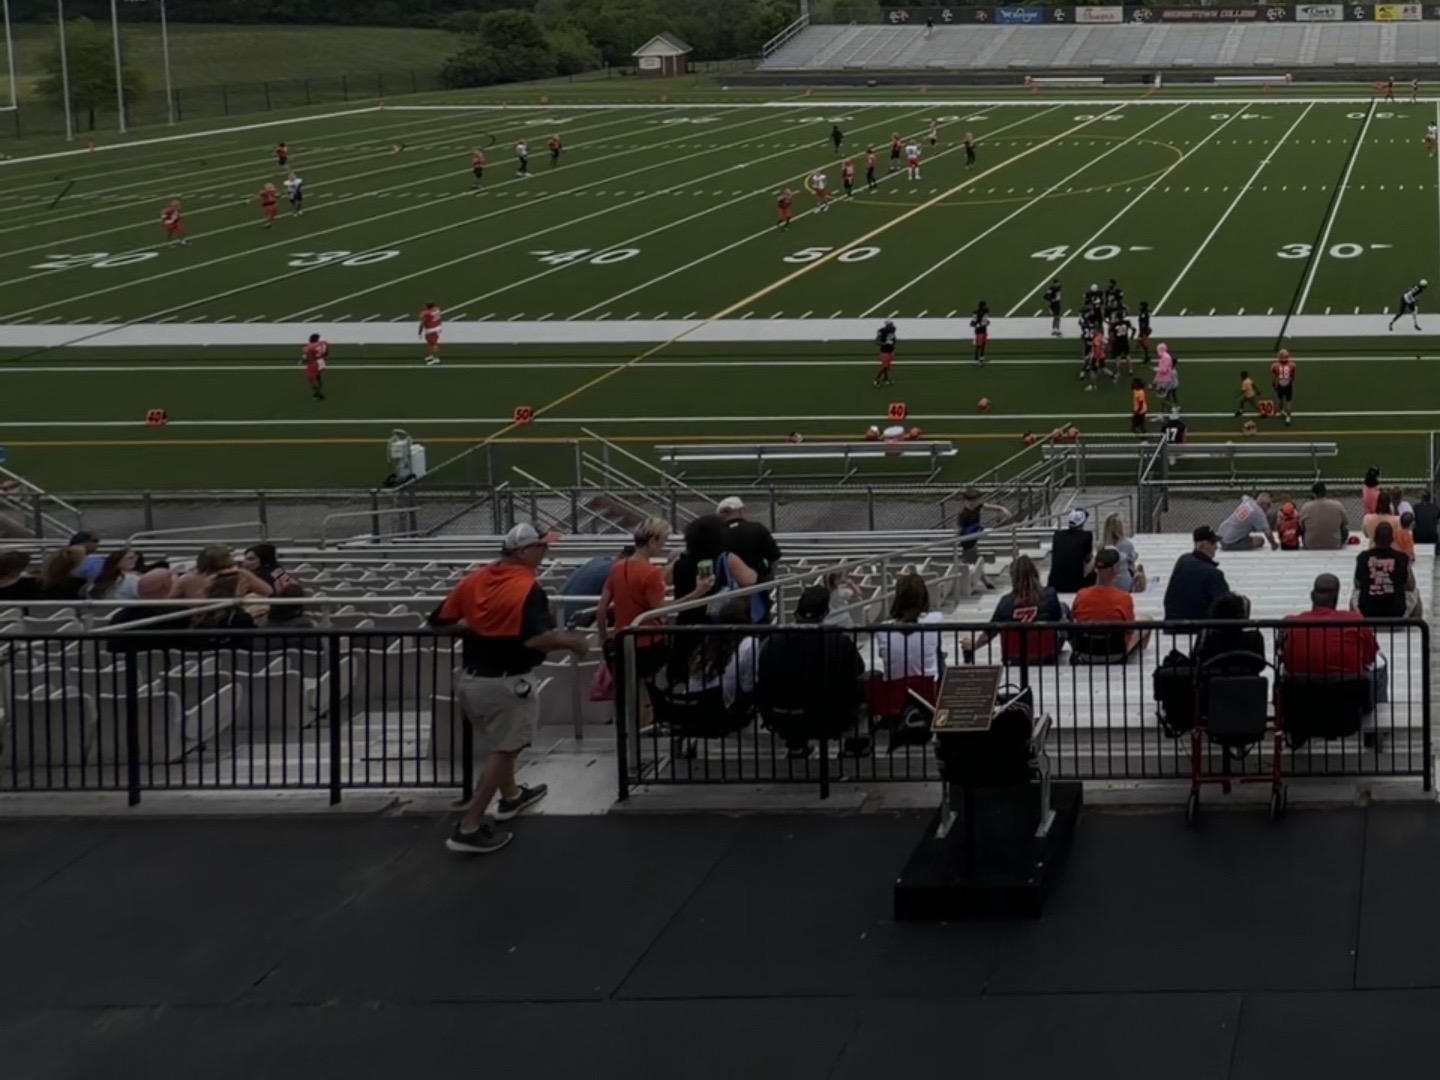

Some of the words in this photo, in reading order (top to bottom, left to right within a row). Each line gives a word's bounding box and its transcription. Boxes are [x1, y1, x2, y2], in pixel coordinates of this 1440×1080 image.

[287, 250, 400, 267] 30
[538, 248, 641, 265] 40
[783, 246, 882, 264] 50
[1030, 244, 1122, 262] 40
[1276, 243, 1364, 260] 30
[515, 408, 529, 421] 50
[1166, 427, 1178, 441] 17
